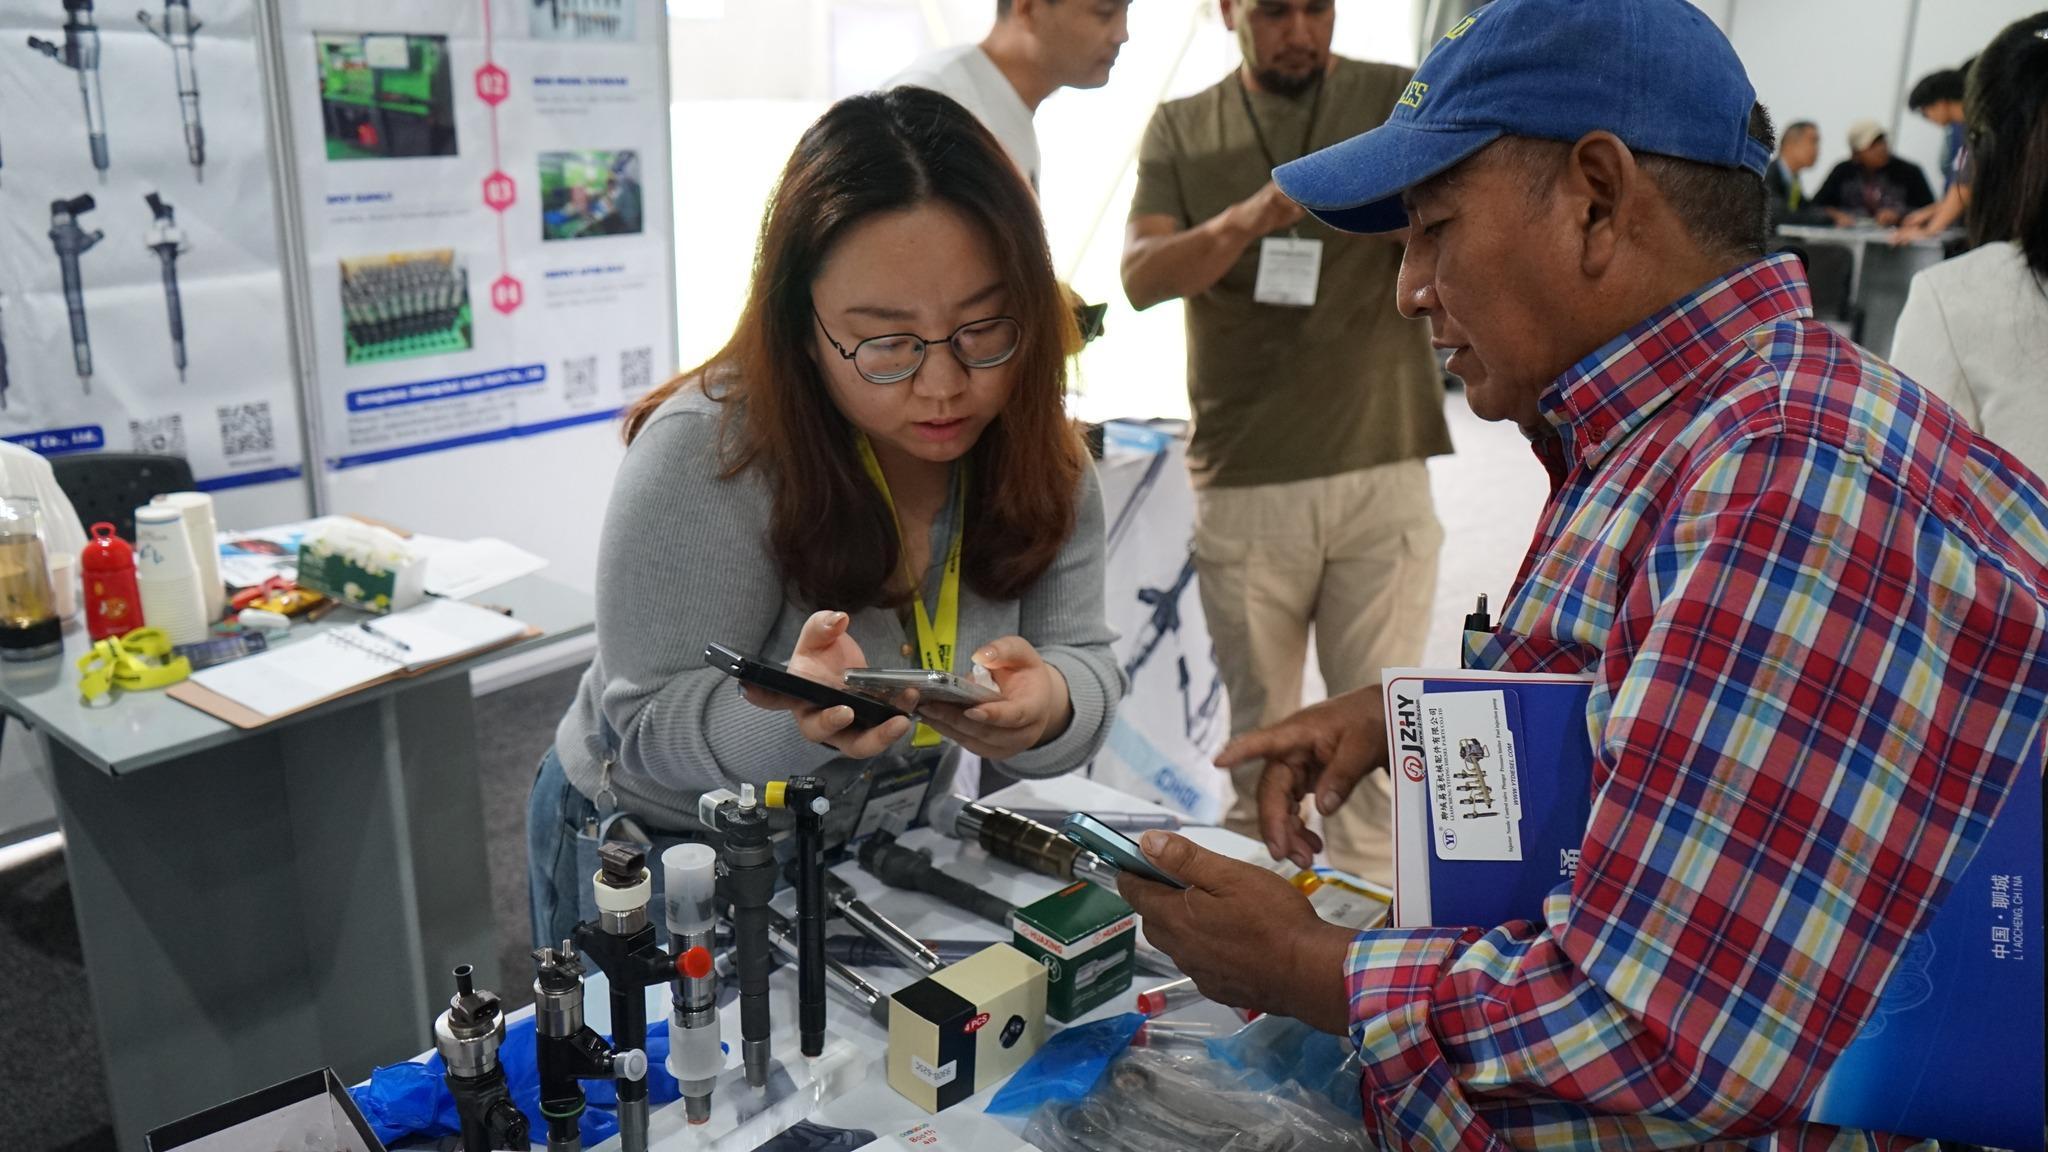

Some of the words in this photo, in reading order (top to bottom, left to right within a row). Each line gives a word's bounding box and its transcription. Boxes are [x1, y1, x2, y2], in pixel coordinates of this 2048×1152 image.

[480, 73, 504, 95] 02
[488, 180, 513, 201] 03
[495, 285, 519, 305] 04
[1397, 694, 1426, 758] JZHY
